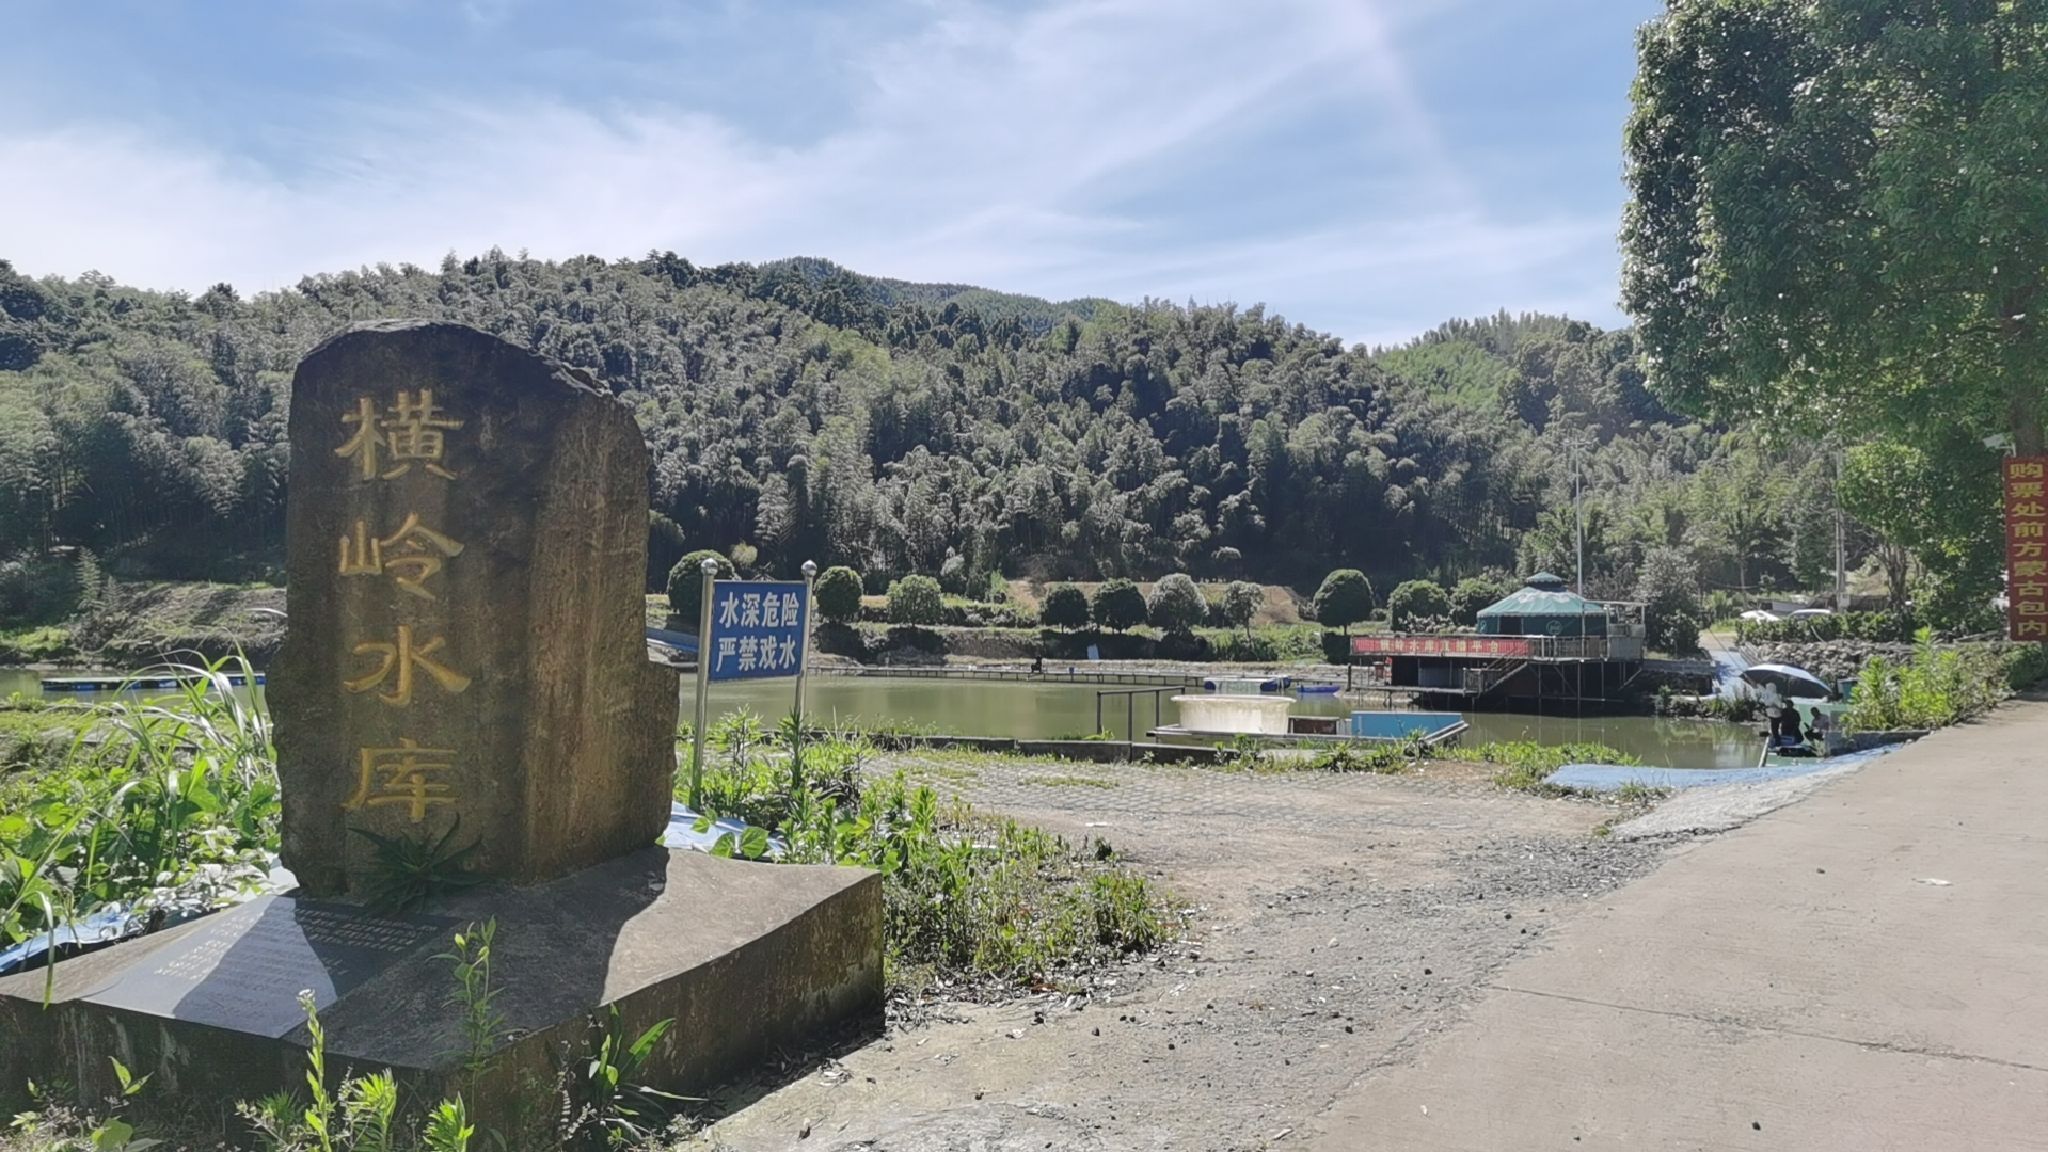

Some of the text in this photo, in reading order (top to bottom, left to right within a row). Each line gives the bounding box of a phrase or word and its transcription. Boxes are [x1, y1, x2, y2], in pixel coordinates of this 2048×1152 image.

[2009, 462, 2048, 637] 购票处前方蒙古包内
[334, 388, 472, 824] 横岭水库
[715, 634, 796, 673] 严禁戏水
[719, 591, 799, 629] 水深危险
